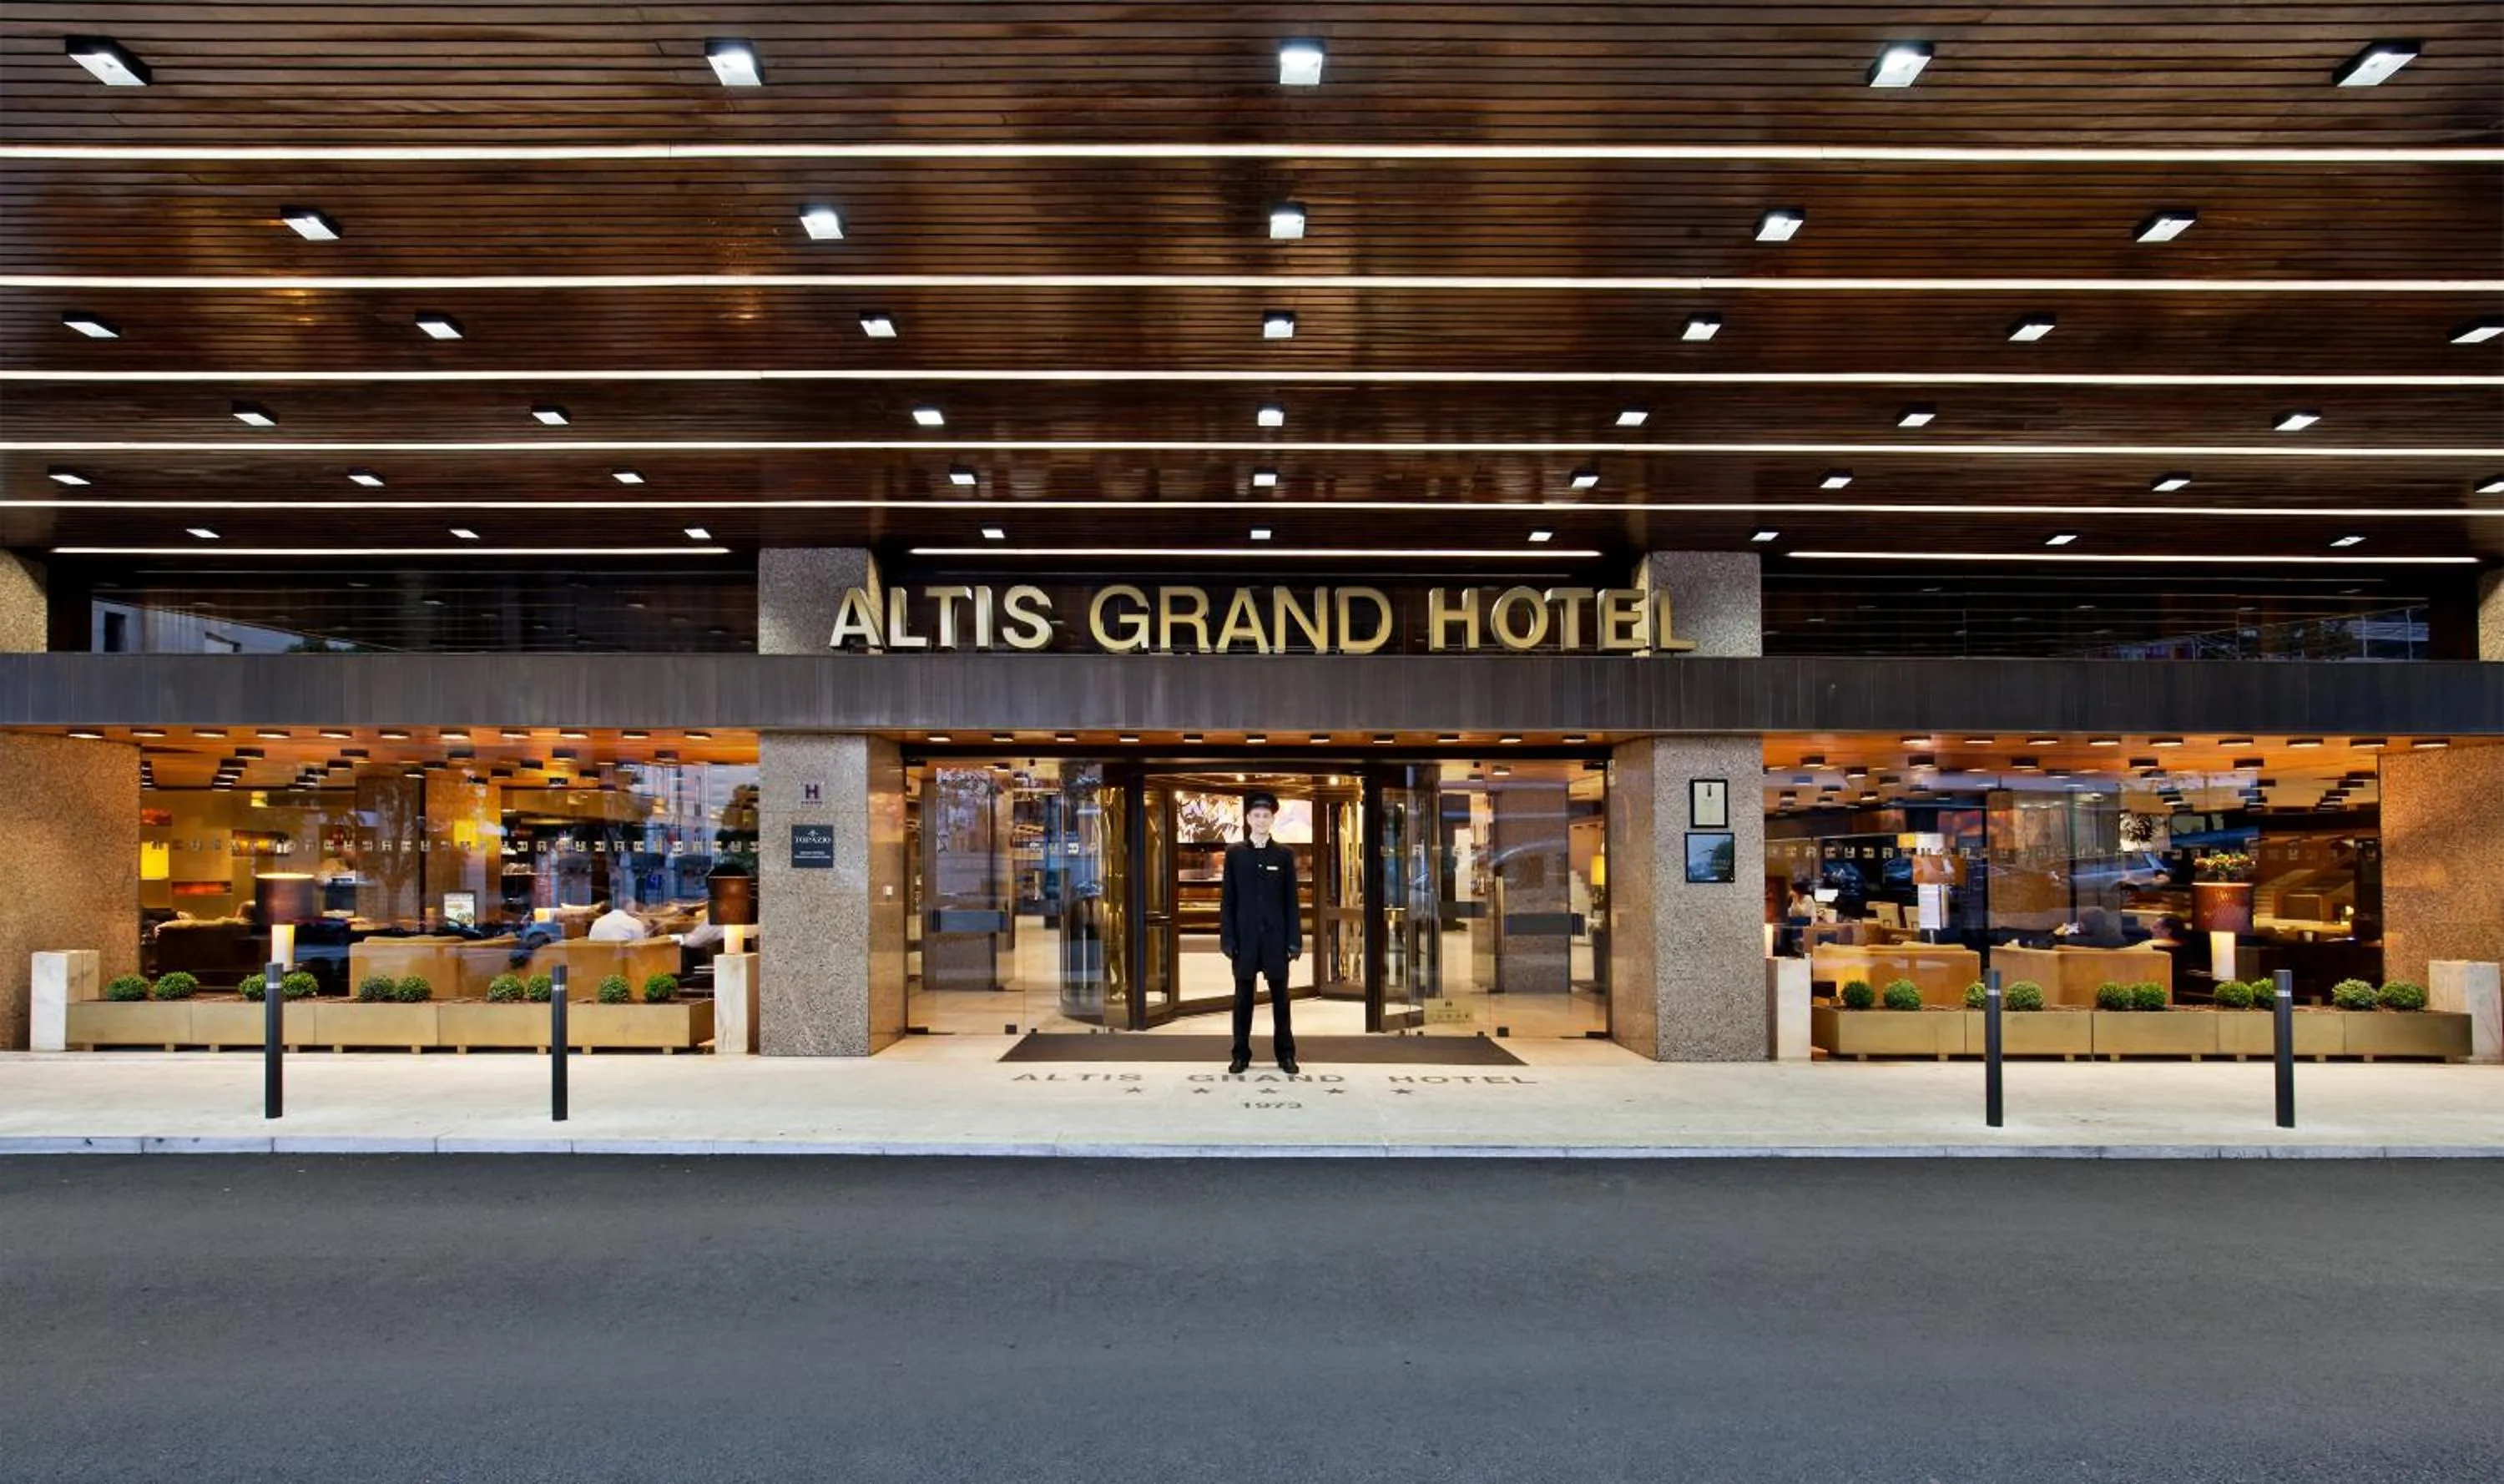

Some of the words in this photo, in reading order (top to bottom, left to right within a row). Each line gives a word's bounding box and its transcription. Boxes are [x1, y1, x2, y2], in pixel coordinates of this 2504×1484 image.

[829, 584, 1053, 650] ALTIS
[1089, 584, 1393, 654] GRAND
[1428, 586, 1697, 651] HOTEL
[805, 784, 819, 799] H
[1011, 1073, 1143, 1082] ALTIS
[1187, 1073, 1346, 1083] GRAND
[1388, 1075, 1537, 1085] HOTEL
[1242, 1101, 1303, 1109] 1973
